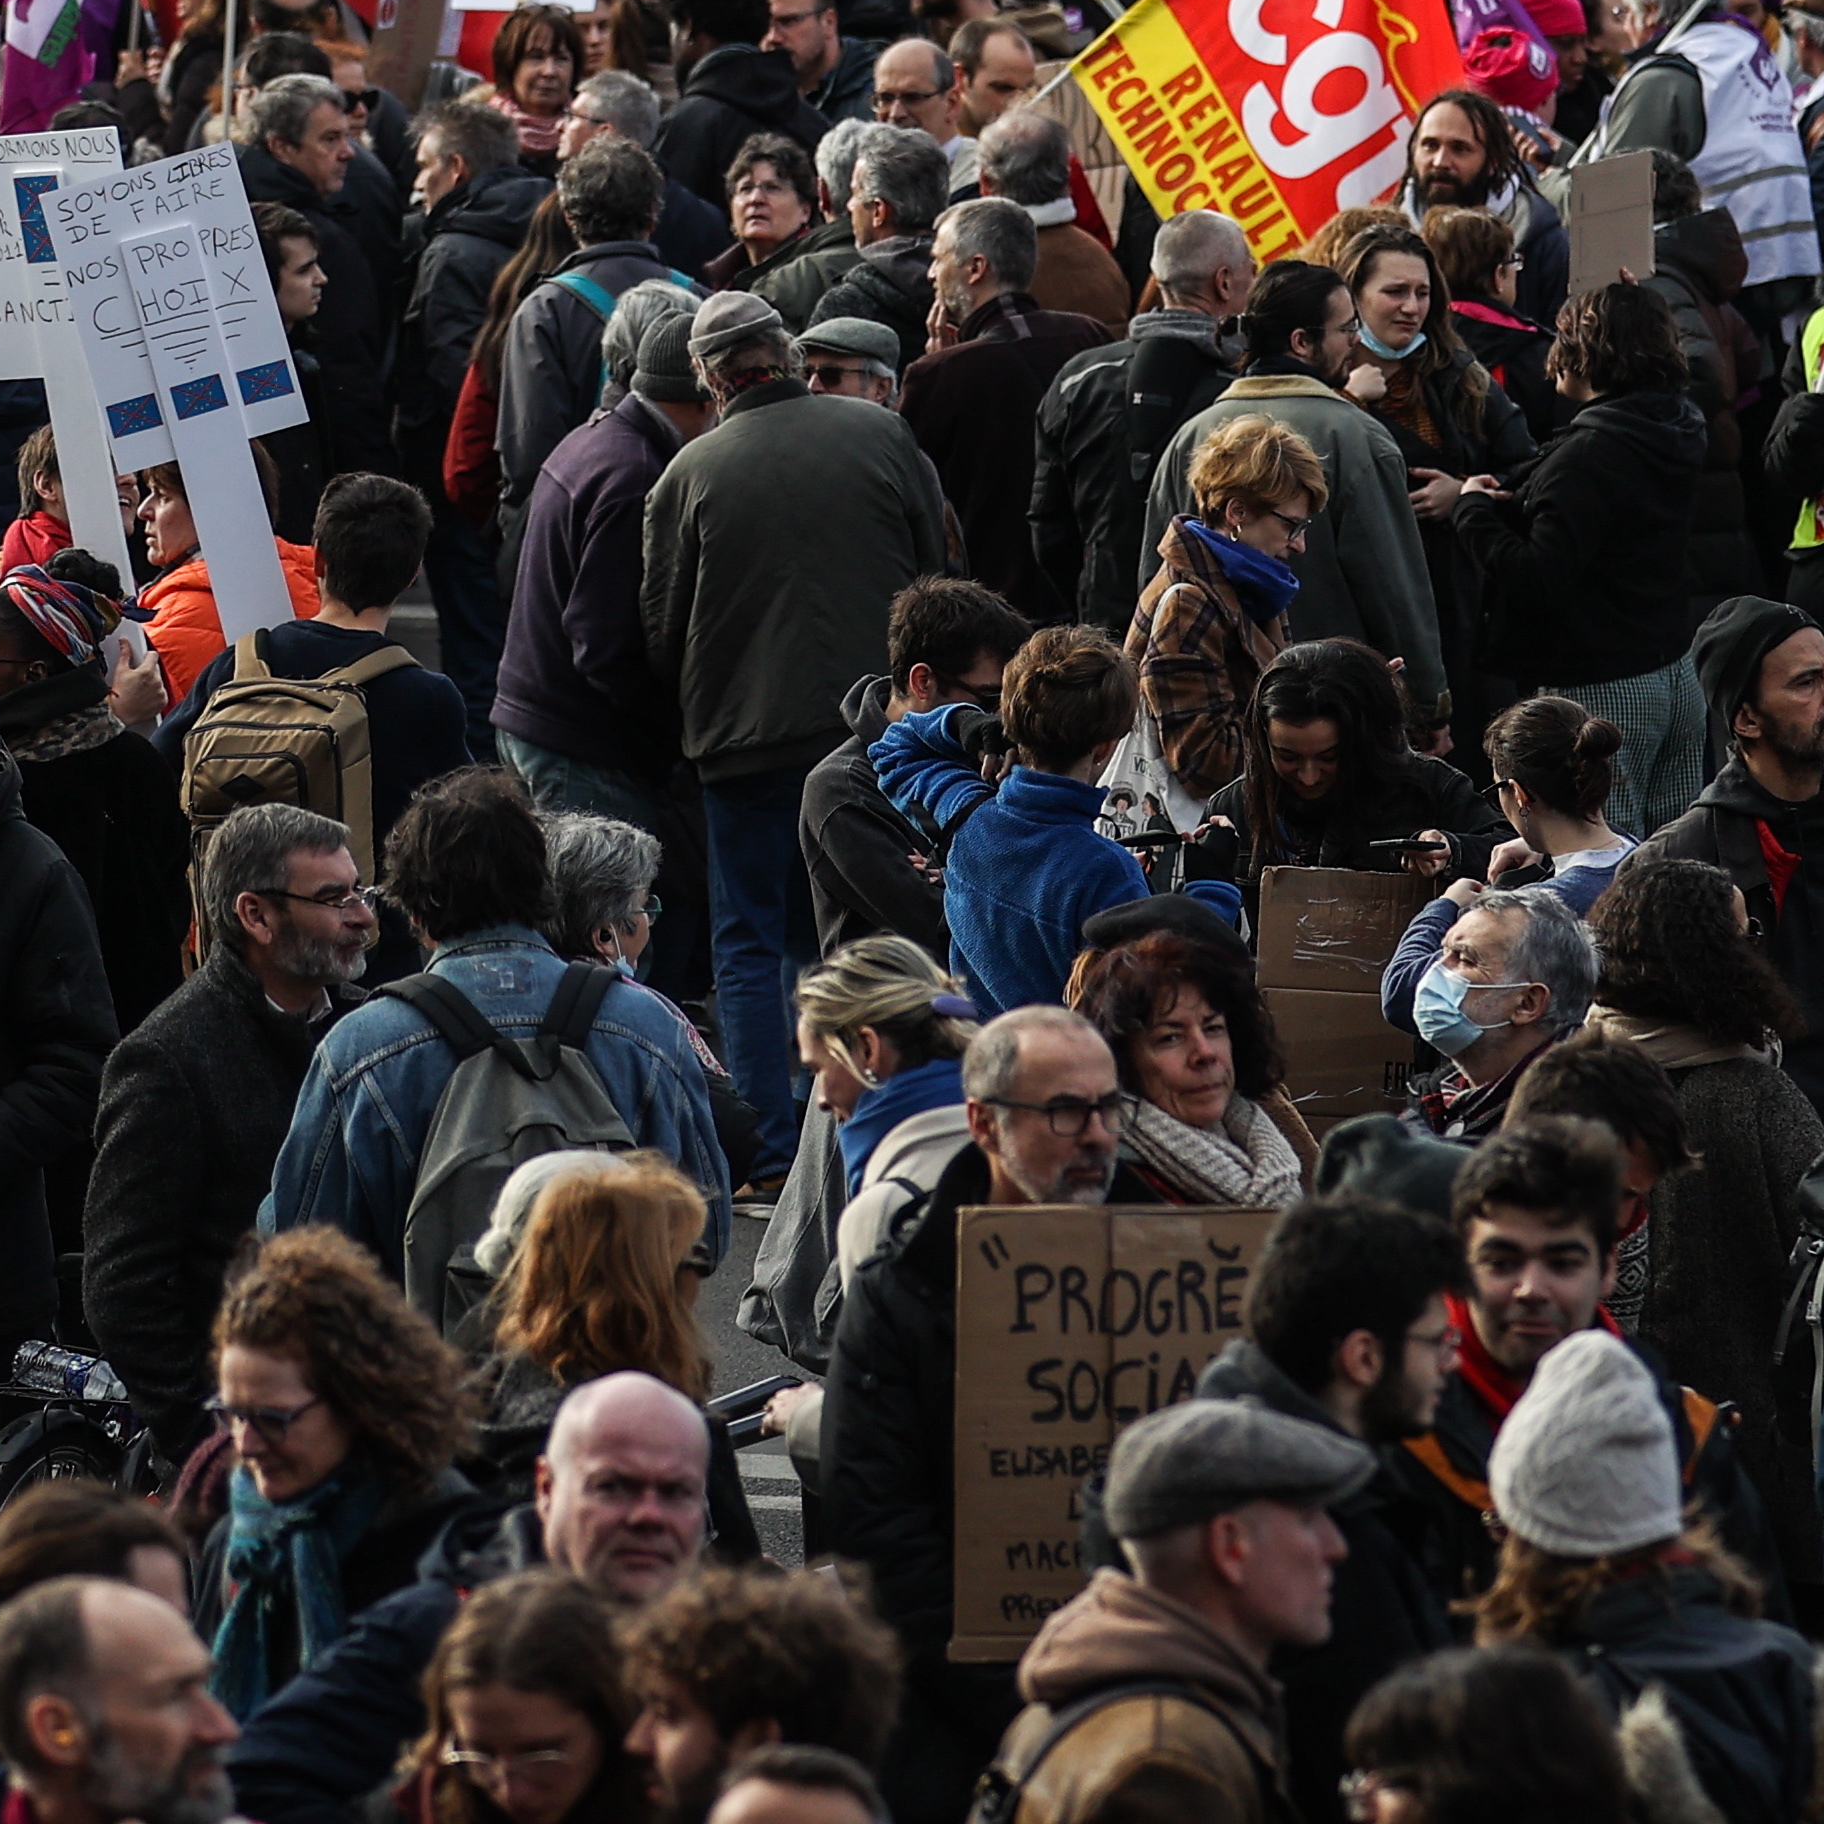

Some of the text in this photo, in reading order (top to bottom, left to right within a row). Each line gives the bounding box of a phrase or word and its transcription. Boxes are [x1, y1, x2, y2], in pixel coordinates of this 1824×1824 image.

[65, 132, 117, 159] NOUS
[1082, 34, 1219, 216] TECHNOC
[57, 147, 232, 222] SOYONS LIBRES
[1162, 63, 1304, 264] RENAULT
[66, 178, 225, 244] DE FAIRE
[66, 255, 119, 288] NOS
